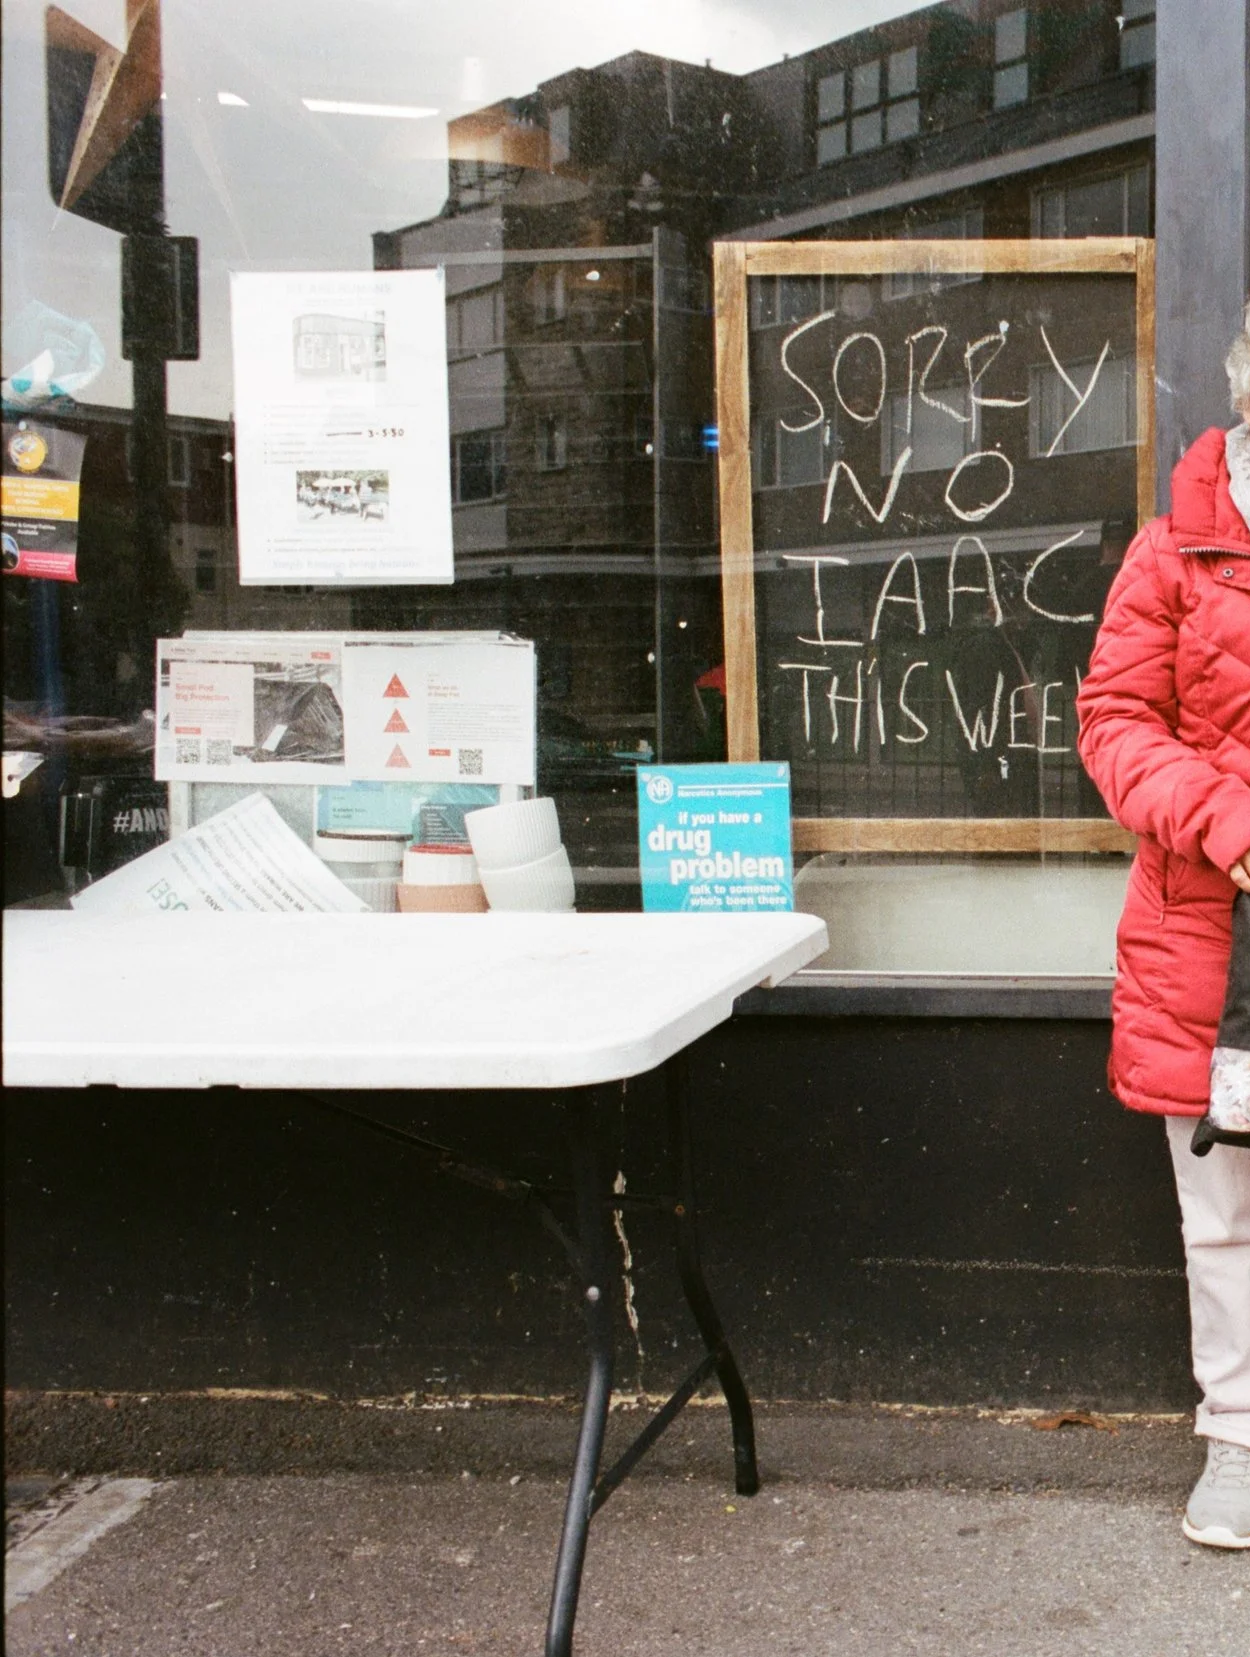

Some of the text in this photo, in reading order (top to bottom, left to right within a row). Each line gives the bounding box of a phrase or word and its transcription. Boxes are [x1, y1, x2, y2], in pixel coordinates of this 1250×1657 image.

[780, 308, 1111, 459] SORRY
[822, 445, 1015, 524] NO
[781, 529, 1095, 648] IAAC
[190, 692, 230, 701] Protection
[779, 657, 1082, 754] THIS WEE
[677, 789, 763, 798] Narcotics Anonymous
[691, 813, 716, 827] you
[718, 811, 750, 824] have
[753, 812, 763, 824] a
[647, 823, 712, 856] drug
[670, 851, 785, 885] problem
[689, 883, 782, 894] talk to someone
[690, 895, 788, 906] who's been there
